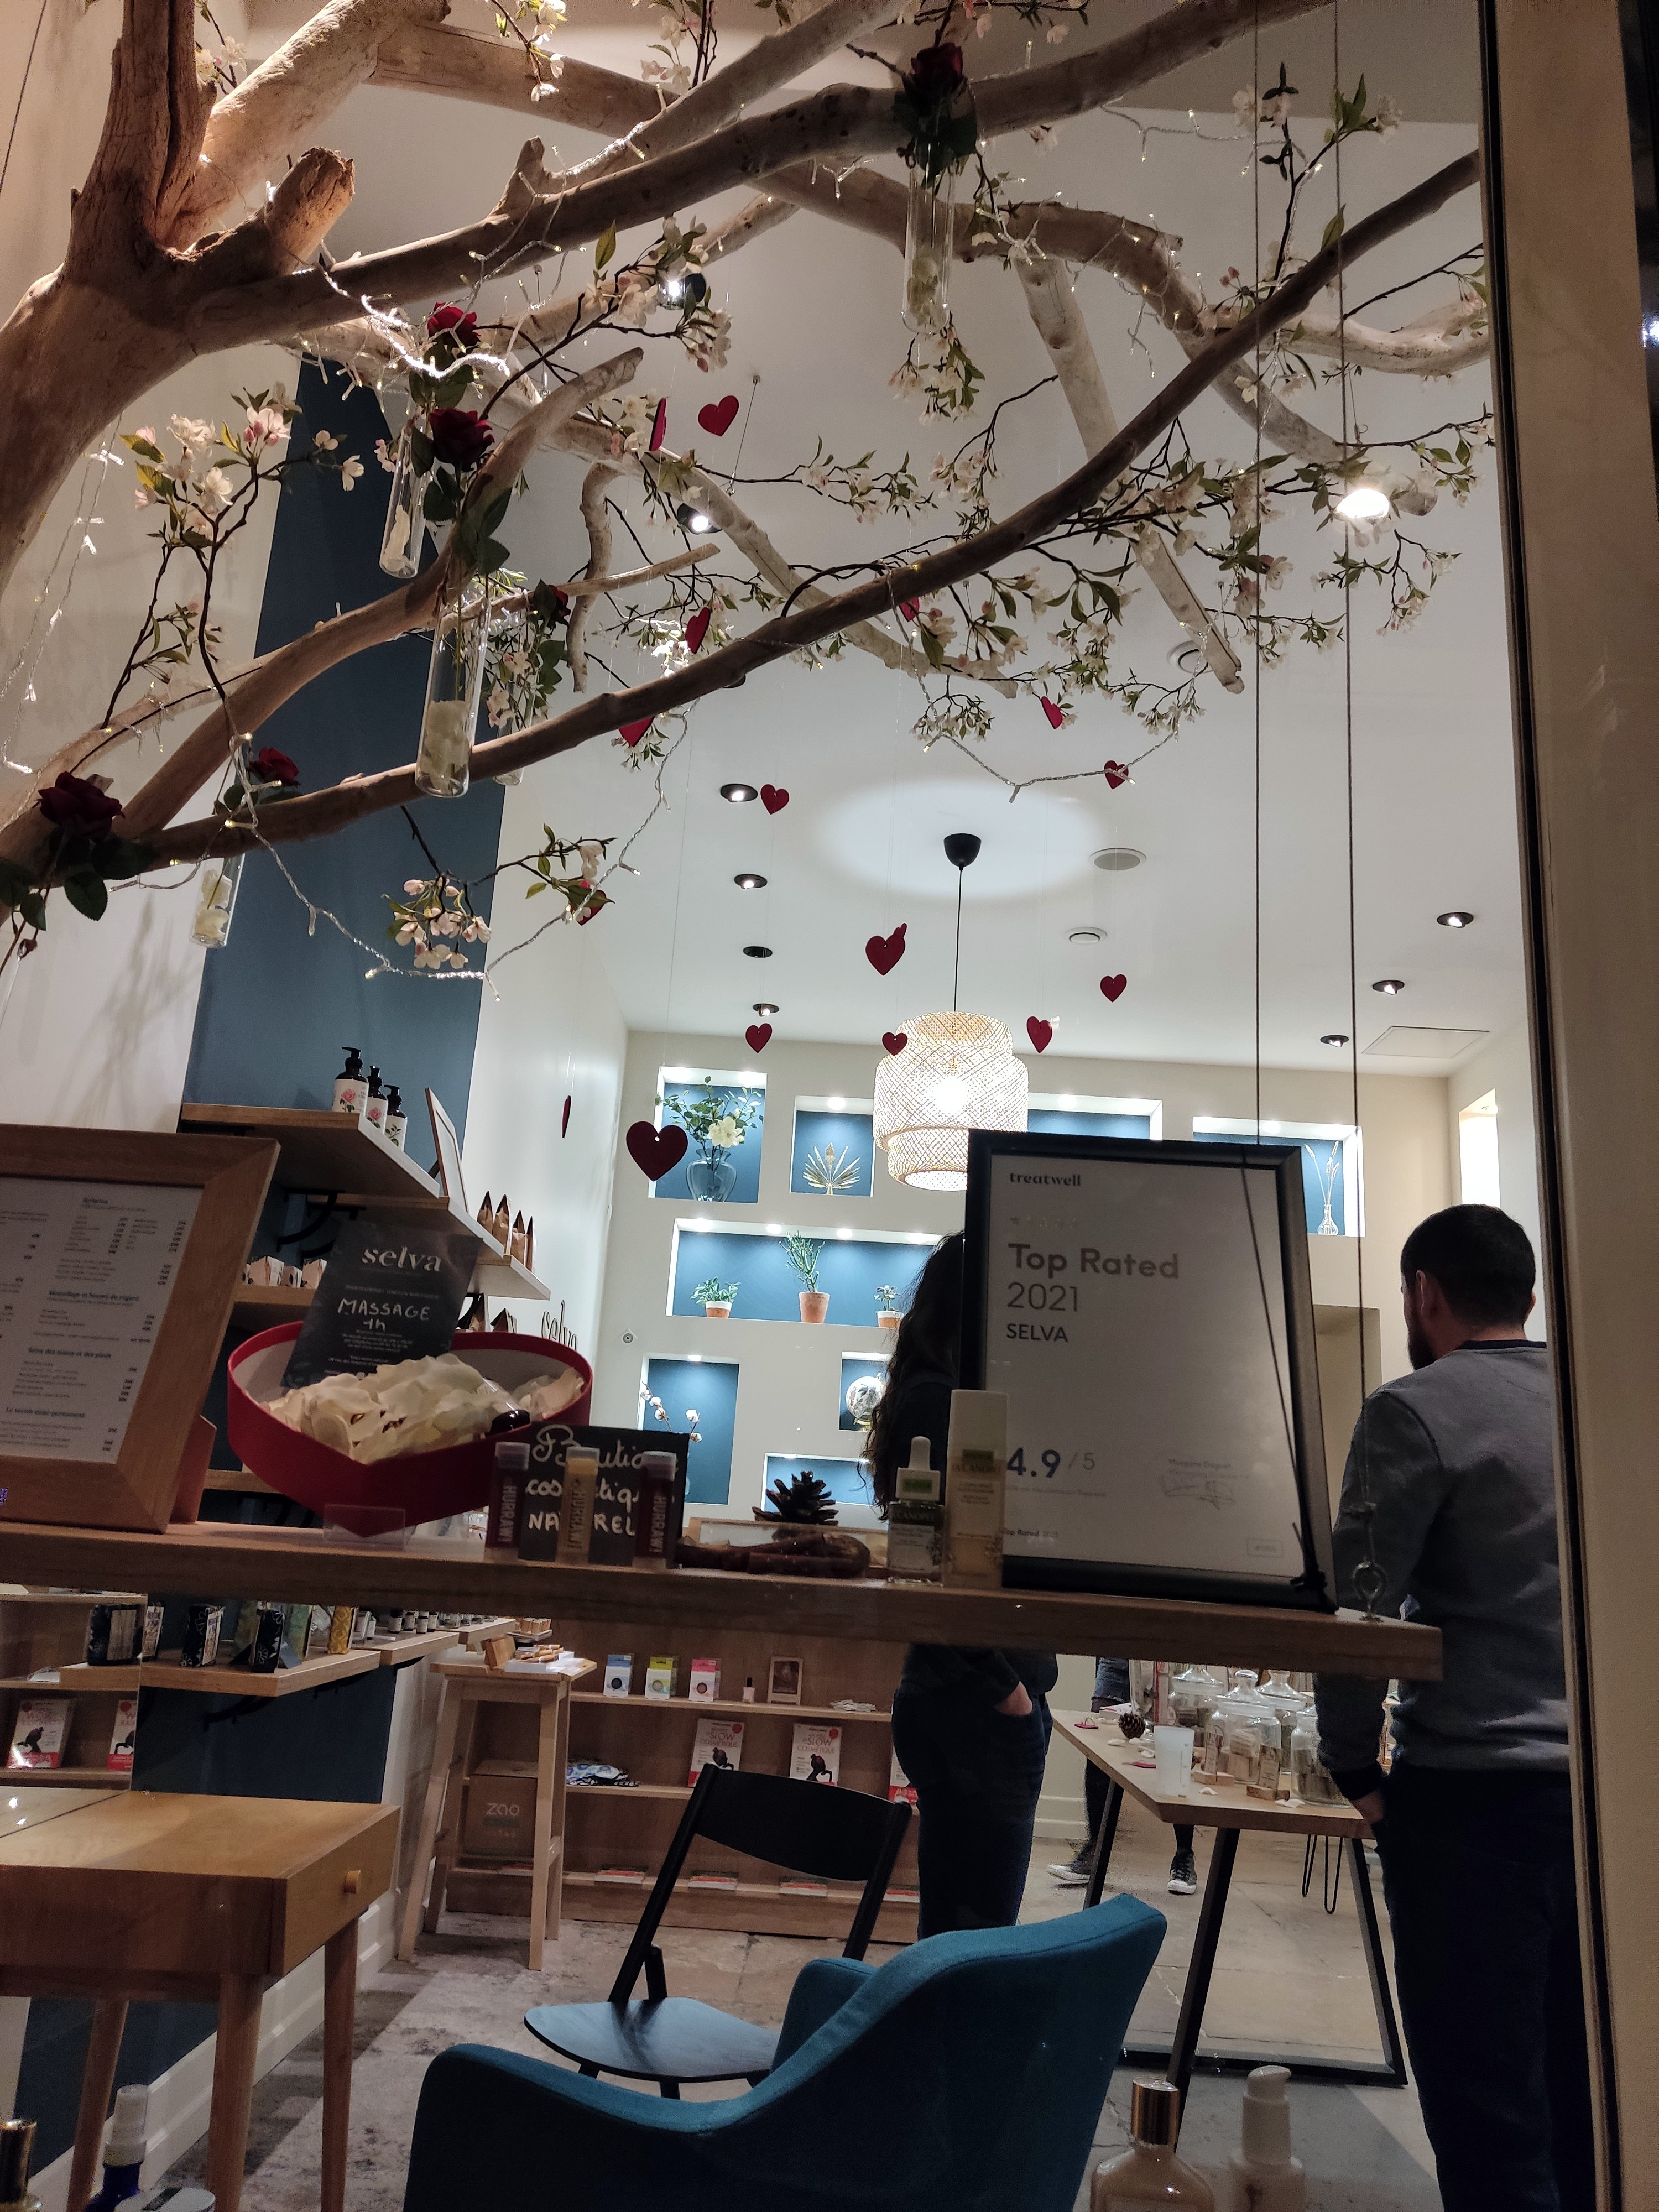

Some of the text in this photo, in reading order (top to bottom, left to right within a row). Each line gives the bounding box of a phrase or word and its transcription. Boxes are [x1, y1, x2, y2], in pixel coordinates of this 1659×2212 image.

[1009, 1172, 1081, 1187] treatwell
[361, 1245, 442, 1272] selva
[1008, 1243, 1179, 1279] Top Rated
[1006, 1281, 1078, 1312] 2021
[337, 1297, 430, 1321] MASSAGE
[363, 1317, 386, 1331] 1h
[1006, 1322, 1068, 1343] SELVA
[1006, 1447, 1061, 1478] 4.9
[528, 1511, 635, 1536] NAREL
[709, 1731, 736, 1740] SLOW
[807, 1737, 832, 1746] SLOW
